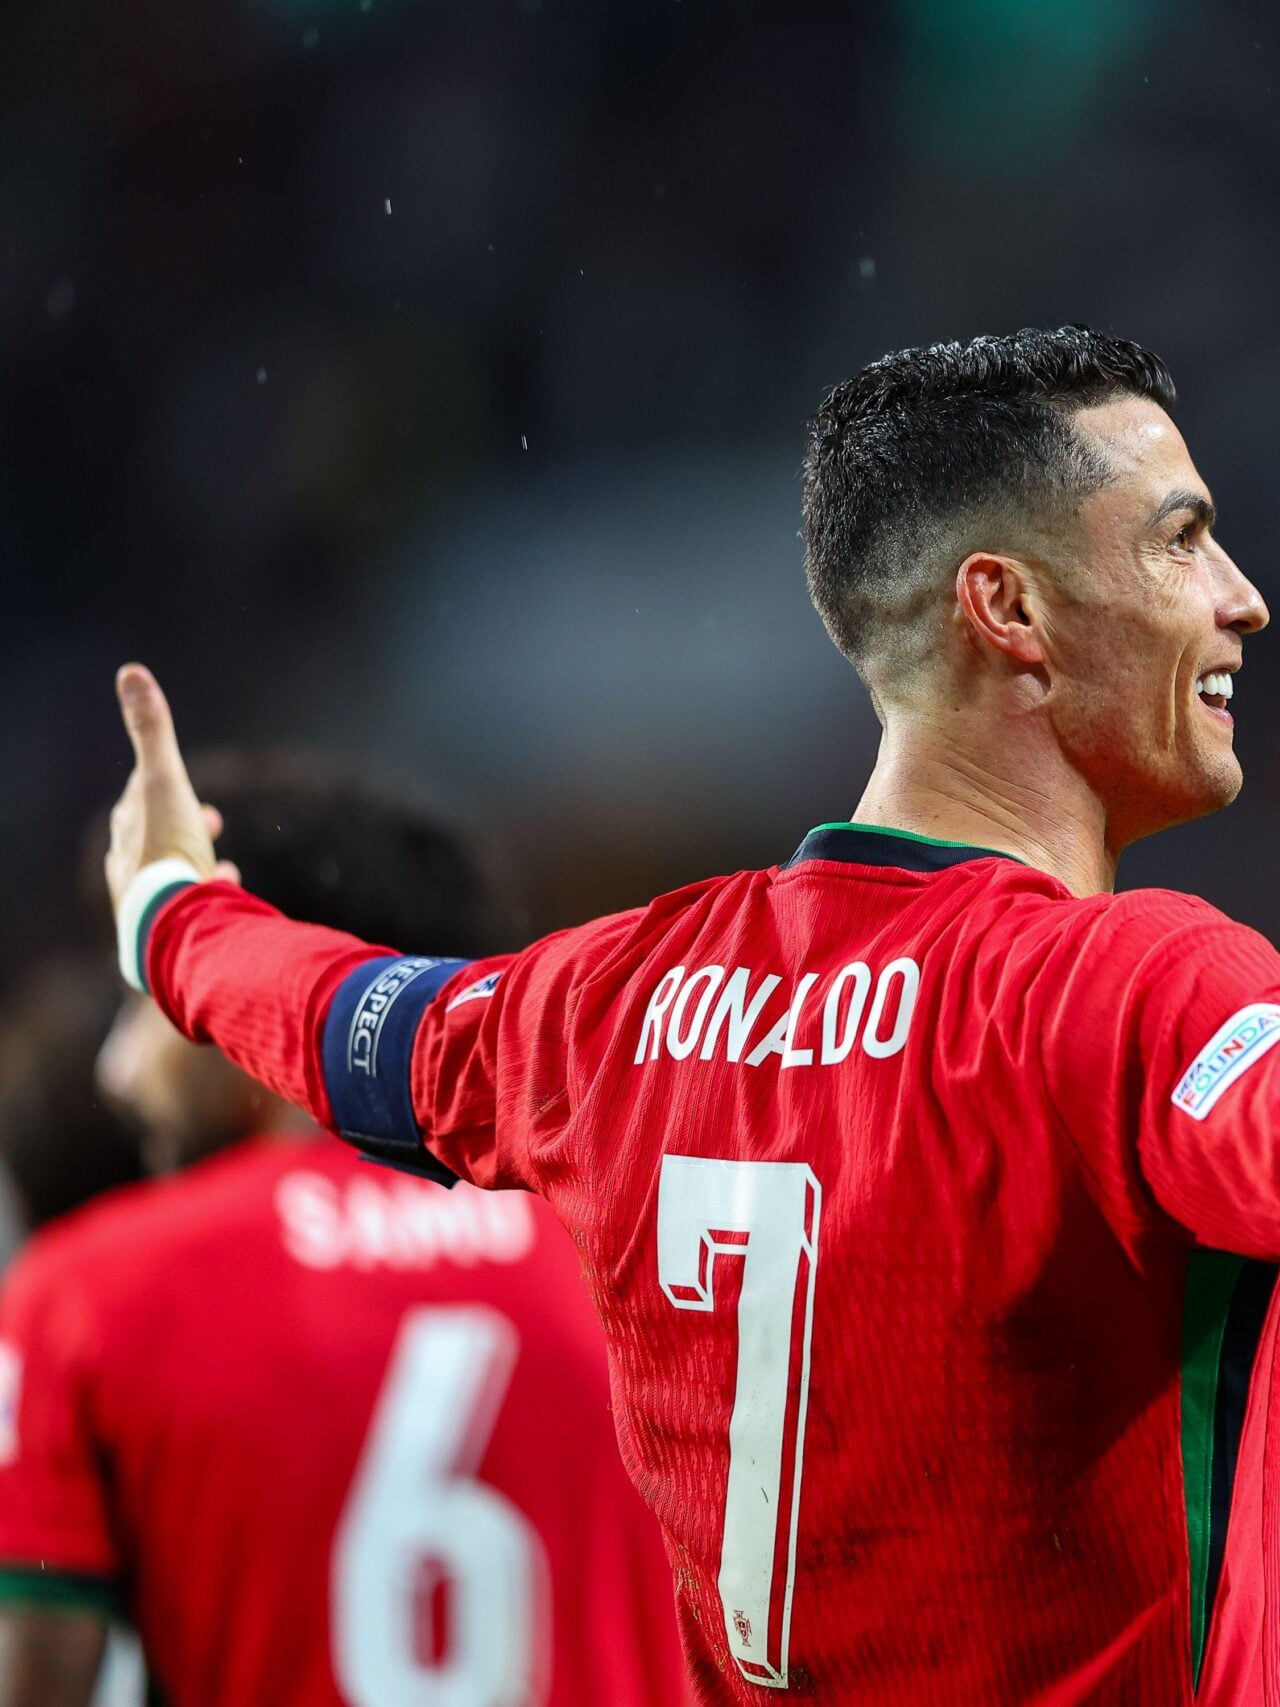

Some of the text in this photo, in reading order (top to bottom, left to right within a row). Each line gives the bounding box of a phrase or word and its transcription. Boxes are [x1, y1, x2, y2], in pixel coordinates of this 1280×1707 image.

[353, 957, 432, 1076] RESPECT
[633, 957, 920, 1070] RONALDO
[330, 1304, 554, 1707] 6
[657, 1153, 822, 1689] 7
